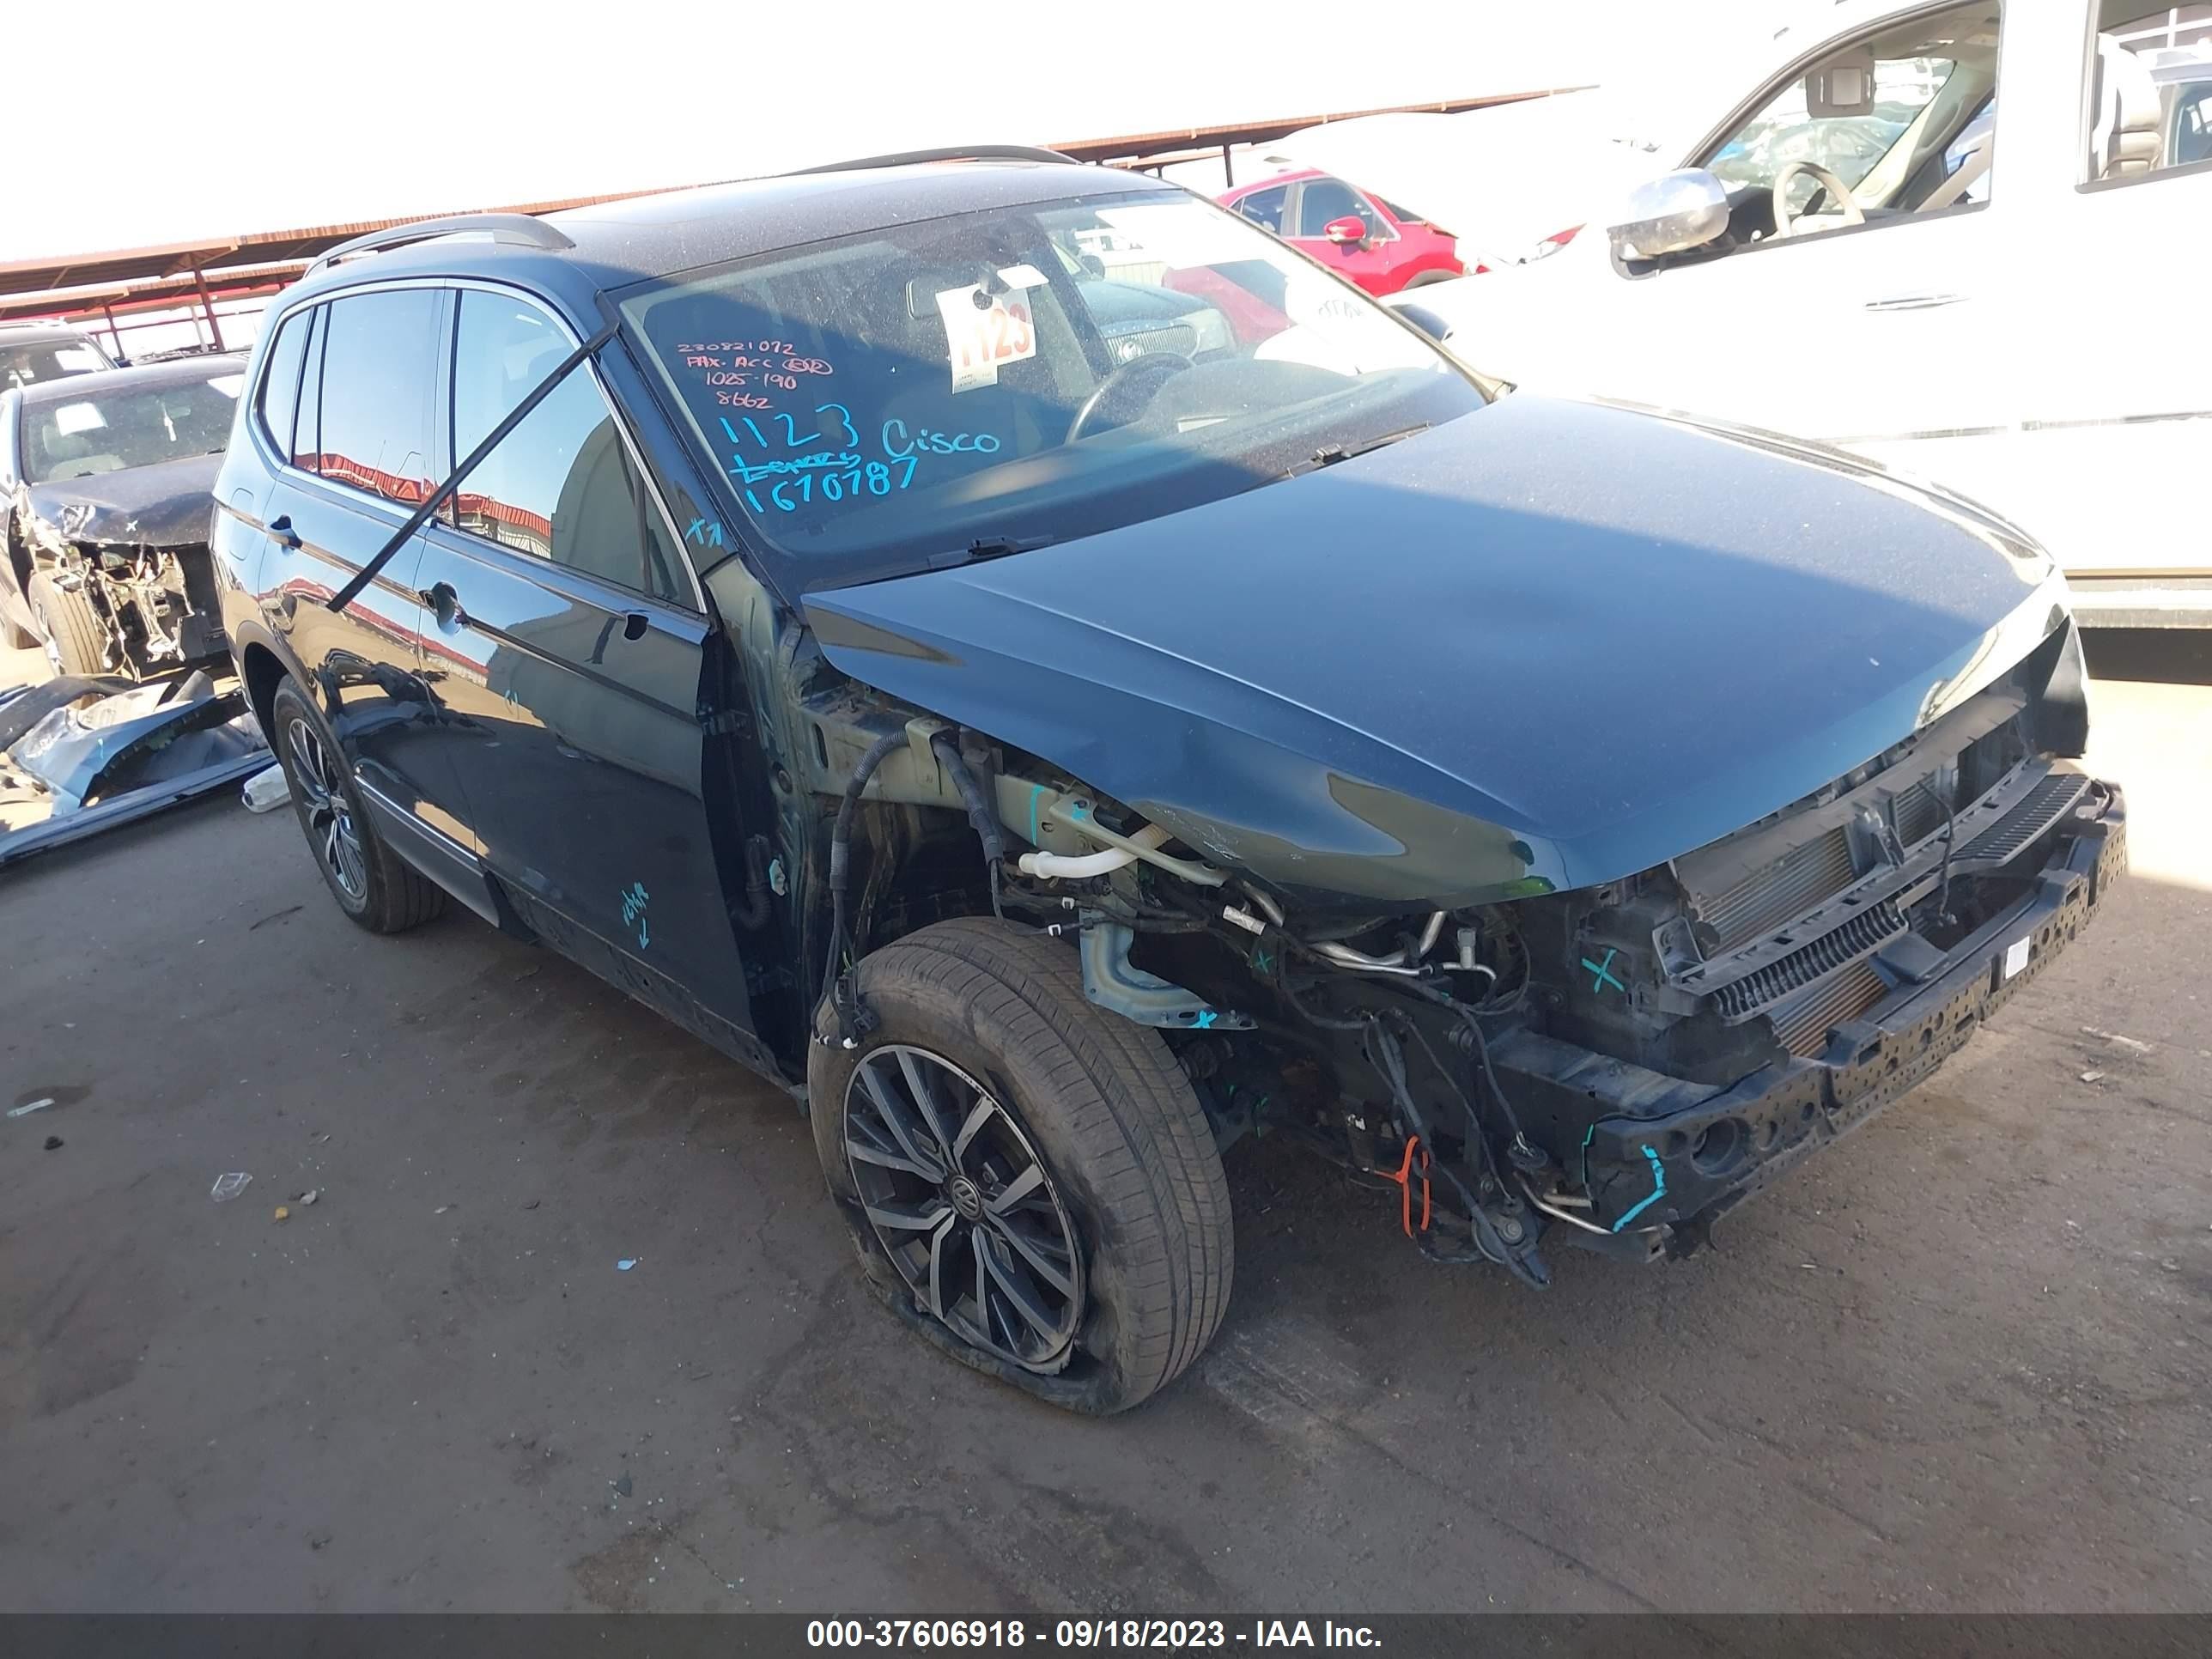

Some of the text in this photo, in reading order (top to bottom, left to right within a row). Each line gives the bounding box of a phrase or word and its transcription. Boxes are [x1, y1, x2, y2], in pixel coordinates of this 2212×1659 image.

[716, 391, 774, 409] 8662
[719, 404, 859, 447] 1123
[883, 419, 1000, 458] Cisco
